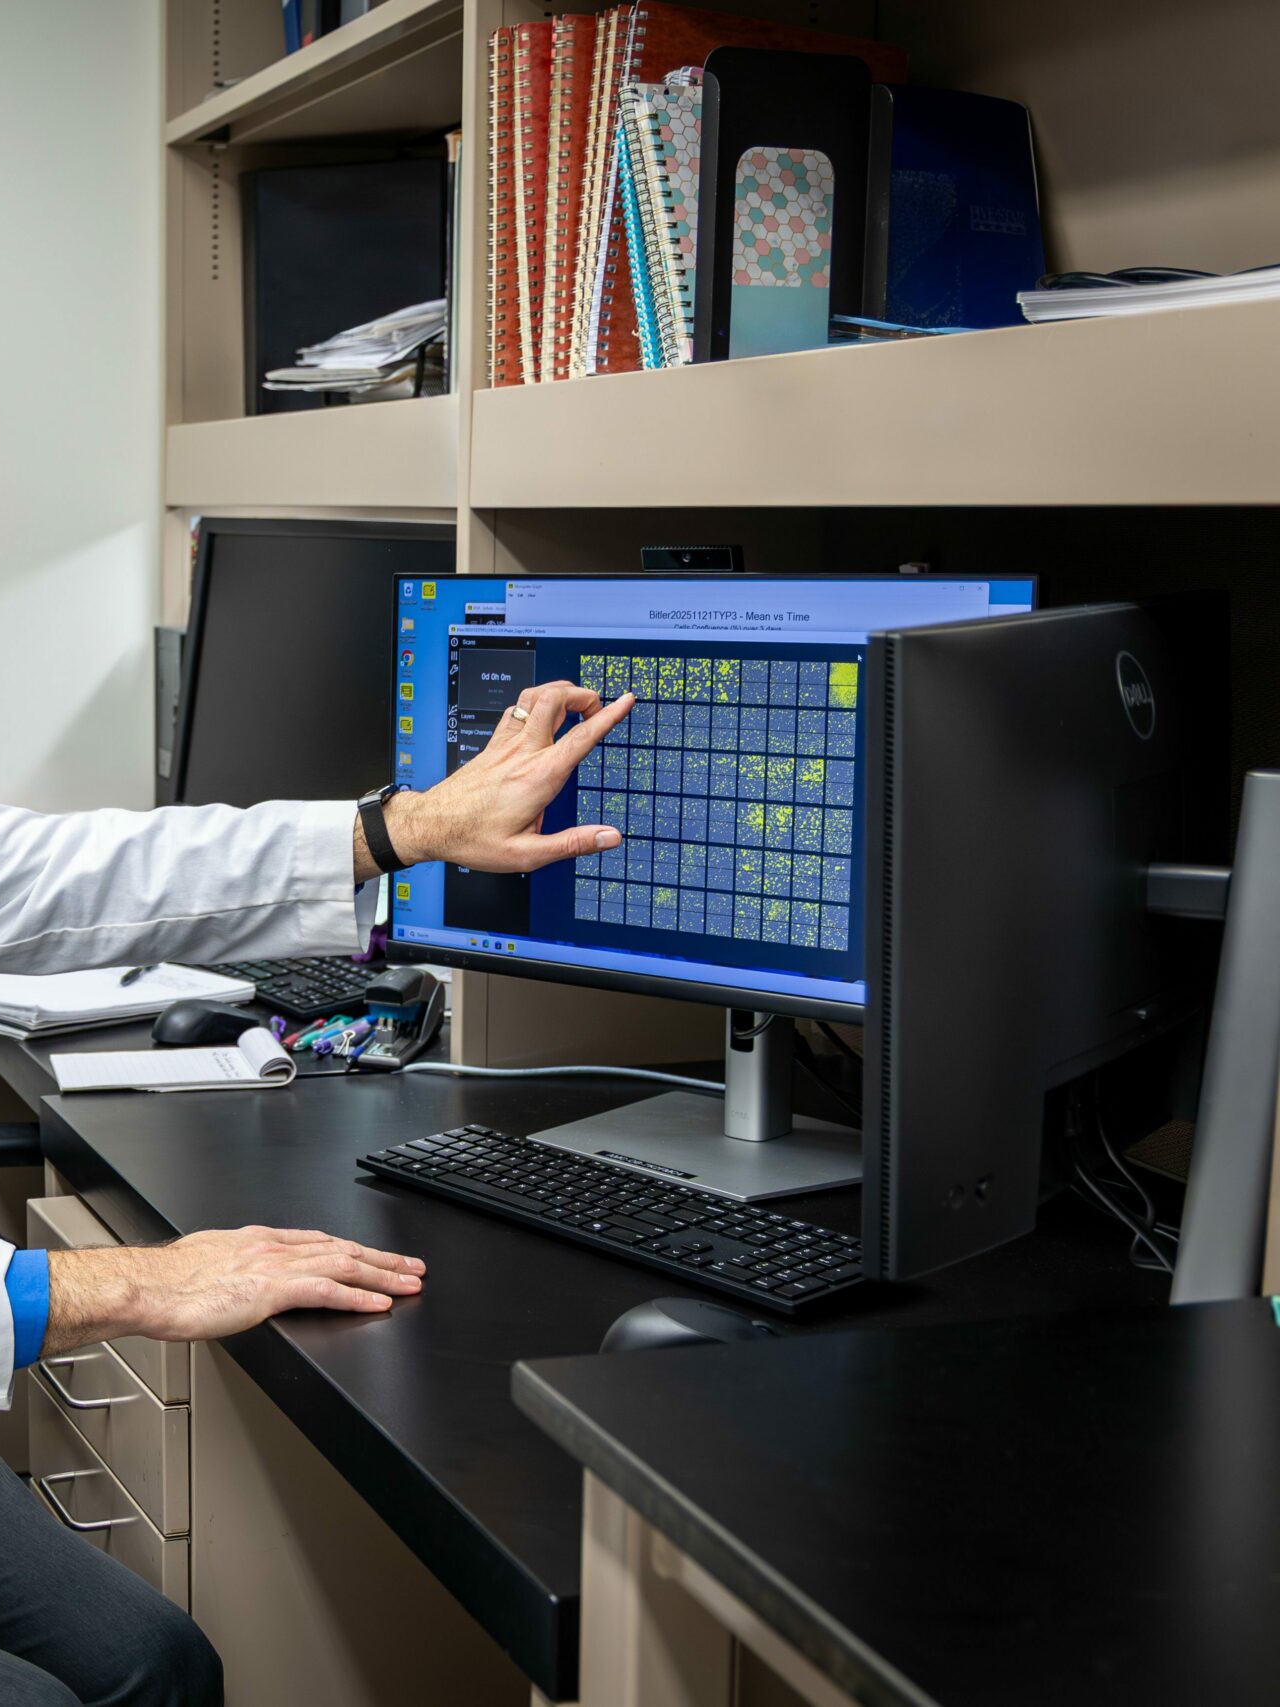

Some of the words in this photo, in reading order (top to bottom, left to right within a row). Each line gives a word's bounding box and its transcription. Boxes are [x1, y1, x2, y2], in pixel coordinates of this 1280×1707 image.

[745, 611, 771, 621] Mean
[773, 613, 784, 621] vs
[786, 611, 810, 622] Time
[481, 673, 490, 681] 0d
[501, 673, 511, 681] 0m
